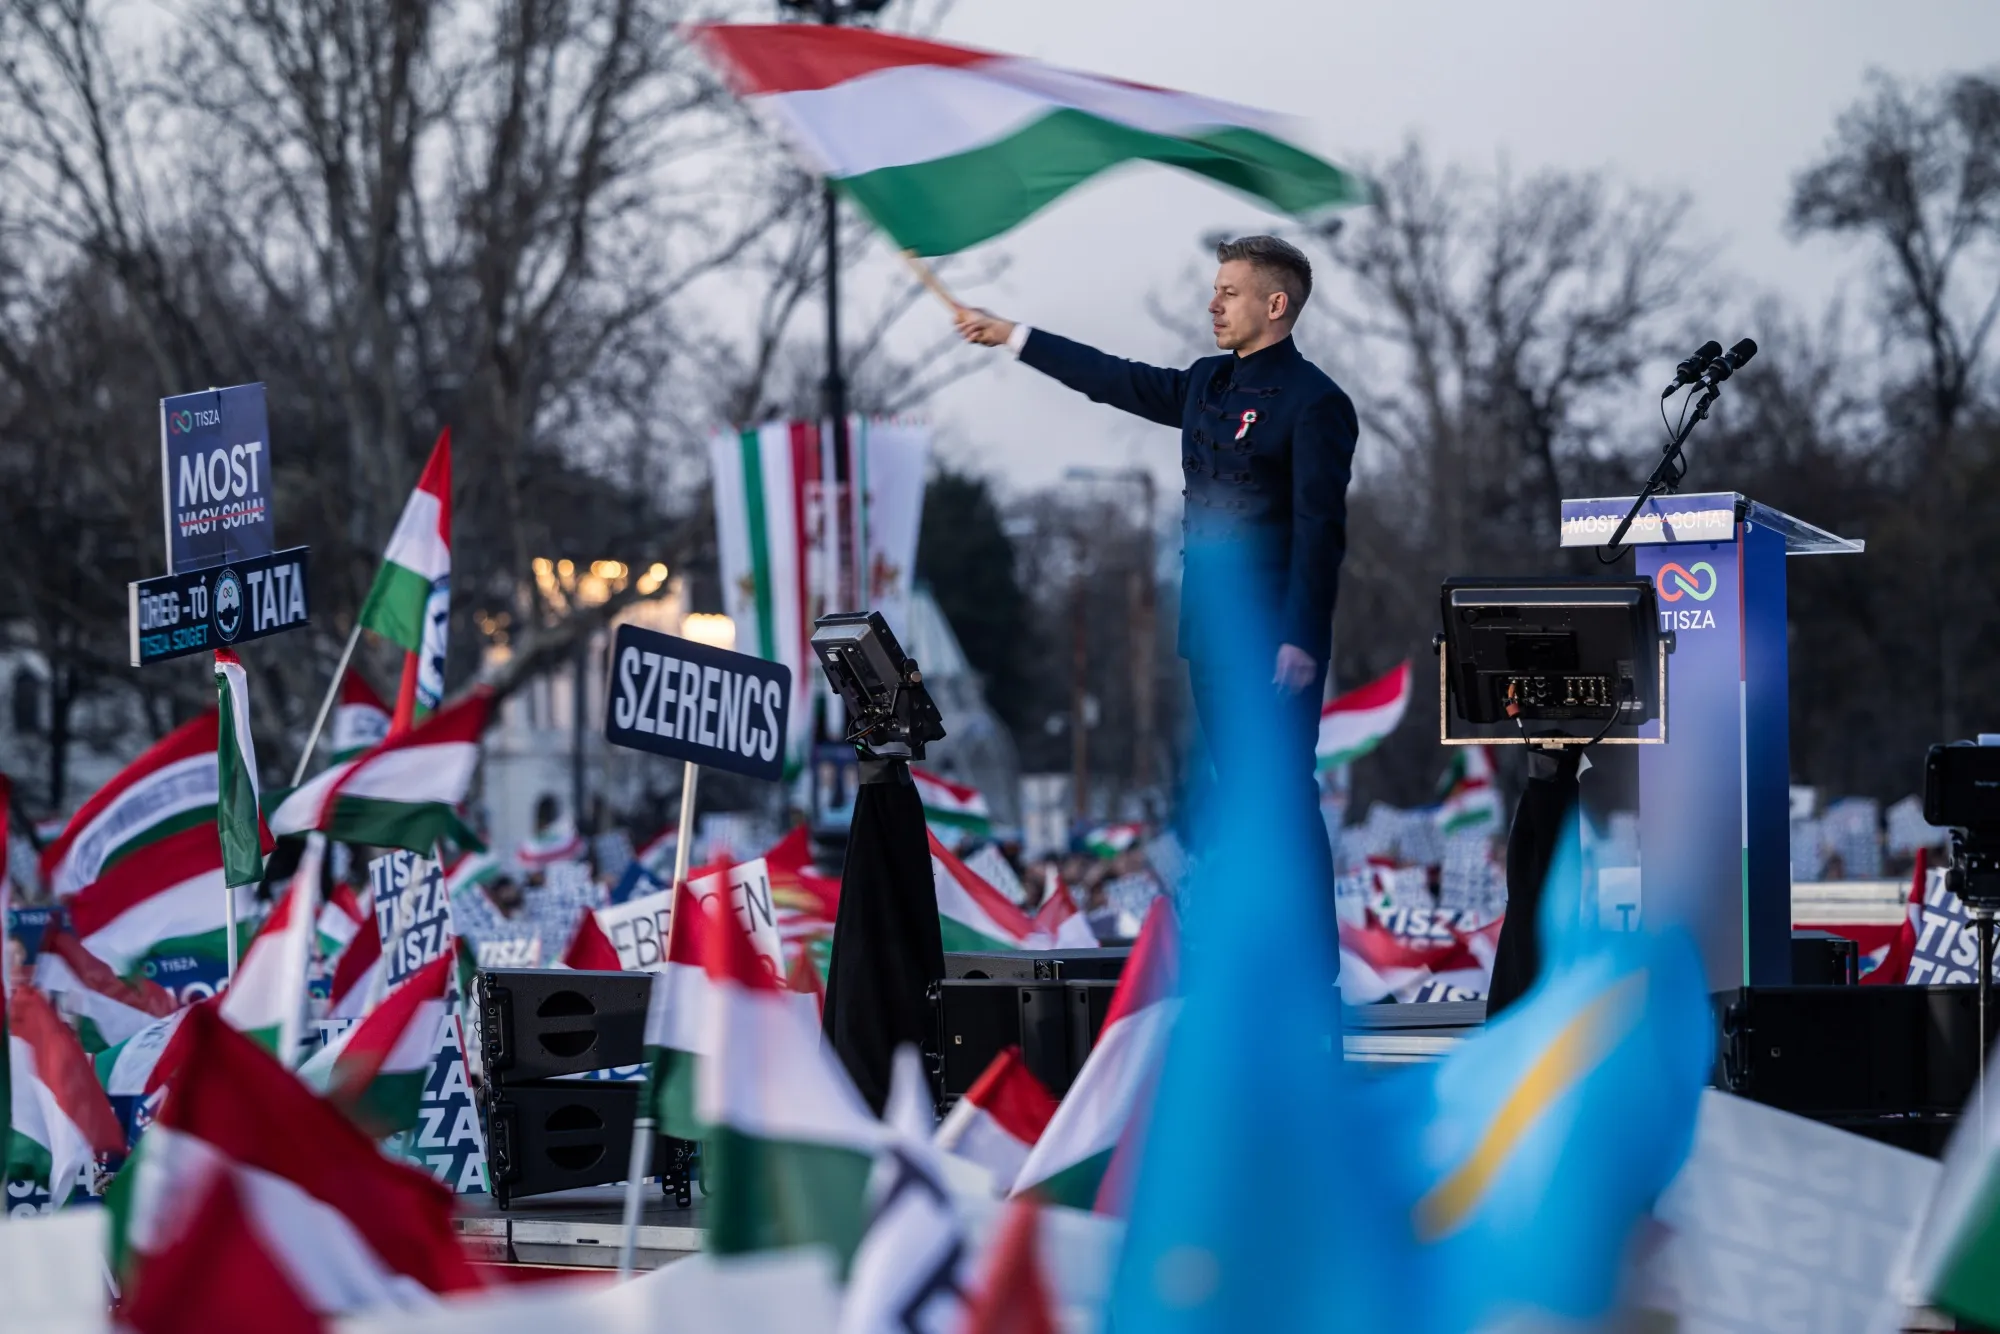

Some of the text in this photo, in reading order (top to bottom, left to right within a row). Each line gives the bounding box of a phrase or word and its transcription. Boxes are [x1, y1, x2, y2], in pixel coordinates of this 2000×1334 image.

[194, 409, 220, 427] TISZA
[178, 441, 263, 508] MOST
[178, 498, 265, 537] VAGY SOHA!
[1567, 514, 1619, 535] MOST
[246, 562, 308, 632] TATA
[1661, 609, 1716, 630] TISZA
[615, 645, 782, 763] SZERENCS
[375, 878, 450, 941] TISZA
